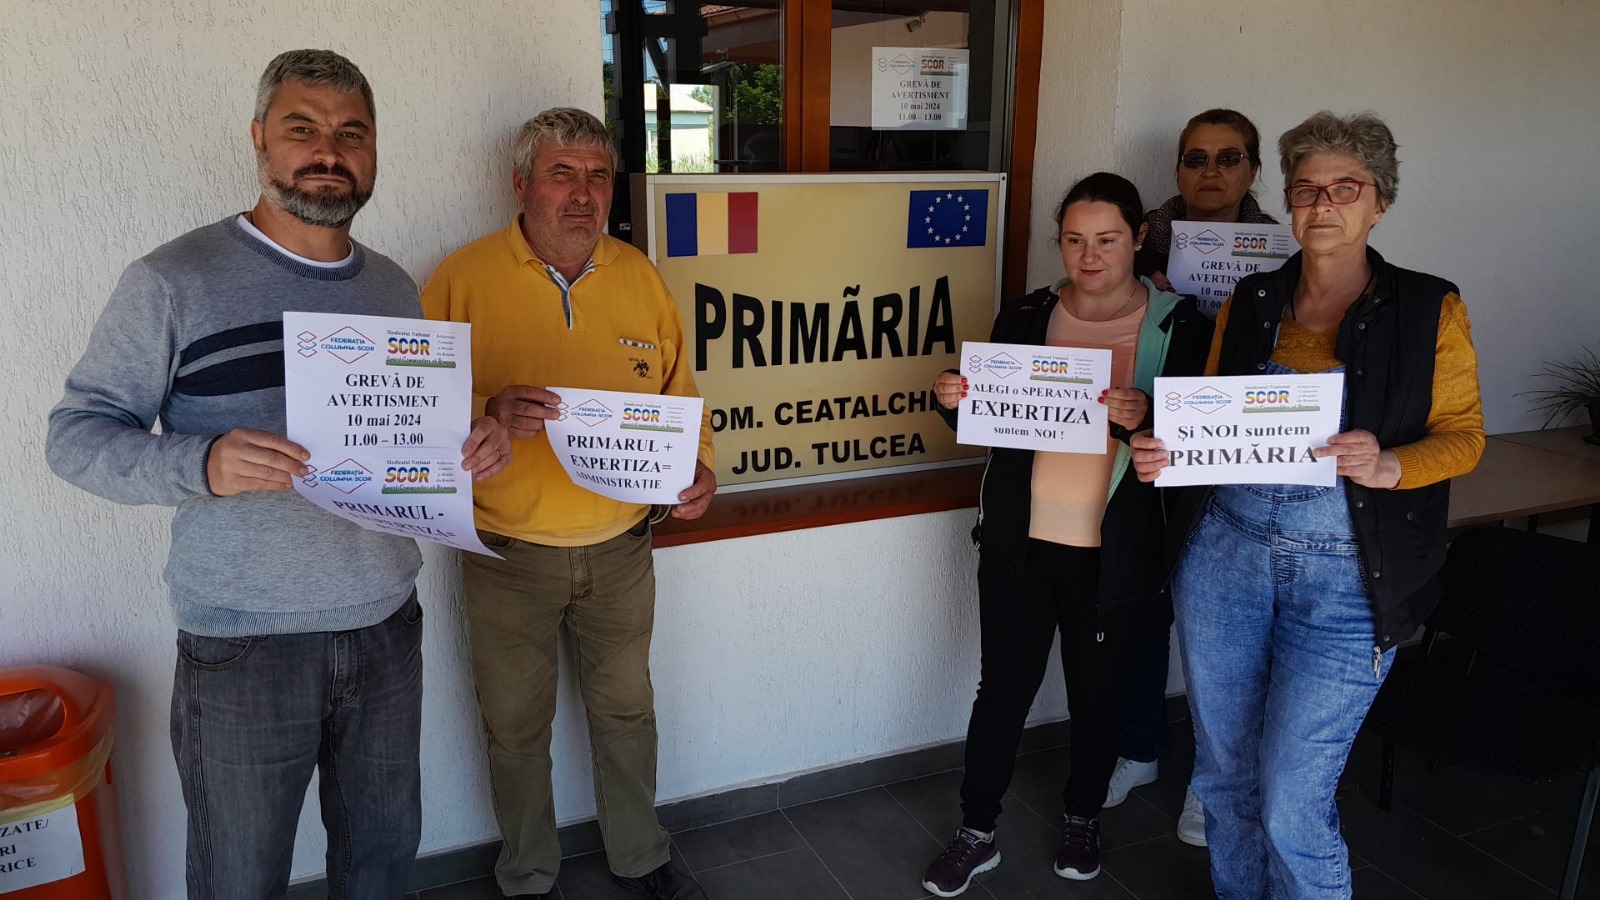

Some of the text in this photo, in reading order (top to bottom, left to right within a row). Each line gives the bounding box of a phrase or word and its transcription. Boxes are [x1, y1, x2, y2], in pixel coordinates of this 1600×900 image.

[921, 59, 945, 69] SCOR
[899, 79, 929, 88] GREVĂ
[900, 102, 940, 110] 10 mai 2024
[1234, 236, 1268, 249] SCOR
[1201, 261, 1241, 272] GREVĂ
[1188, 273, 1241, 284] AVERTIS
[1201, 286, 1211, 296] 10
[330, 337, 366, 345] FEDERAȚIA
[387, 337, 430, 356] SCOR
[1032, 360, 1068, 374] SCOR
[345, 372, 425, 388] GREVĂ DE
[972, 383, 1009, 395] ALEGI
[1022, 386, 1093, 401] SPERANȚĂ,
[1244, 390, 1289, 404] SCOR
[326, 394, 440, 407] AVERTISMENT
[623, 407, 660, 423] SCOR
[710, 406, 763, 432] OM.
[774, 389, 938, 426] CEATALCHI
[971, 400, 1091, 425] EXPERTIZA
[348, 414, 421, 427] 10 mai 2024
[994, 426, 1064, 439] suntem NOI !
[1200, 424, 1239, 438] NOI
[1245, 424, 1310, 437] suntem
[343, 433, 378, 446] 11.00
[393, 432, 424, 445] 13.00
[567, 434, 673, 452] PRIMARUL +
[732, 433, 926, 475] JUD. TULCEA
[1170, 443, 1319, 467] PRIMĂRIA
[570, 454, 672, 473] EXPERTIZA=
[385, 467, 430, 483] SCOR
[575, 471, 662, 491] ADMINISTRAȚIE
[332, 500, 434, 520] PRIMARUL
[0, 818, 49, 837] ZATE/
[0, 844, 17, 857] RI
[0, 857, 37, 874] RICE
